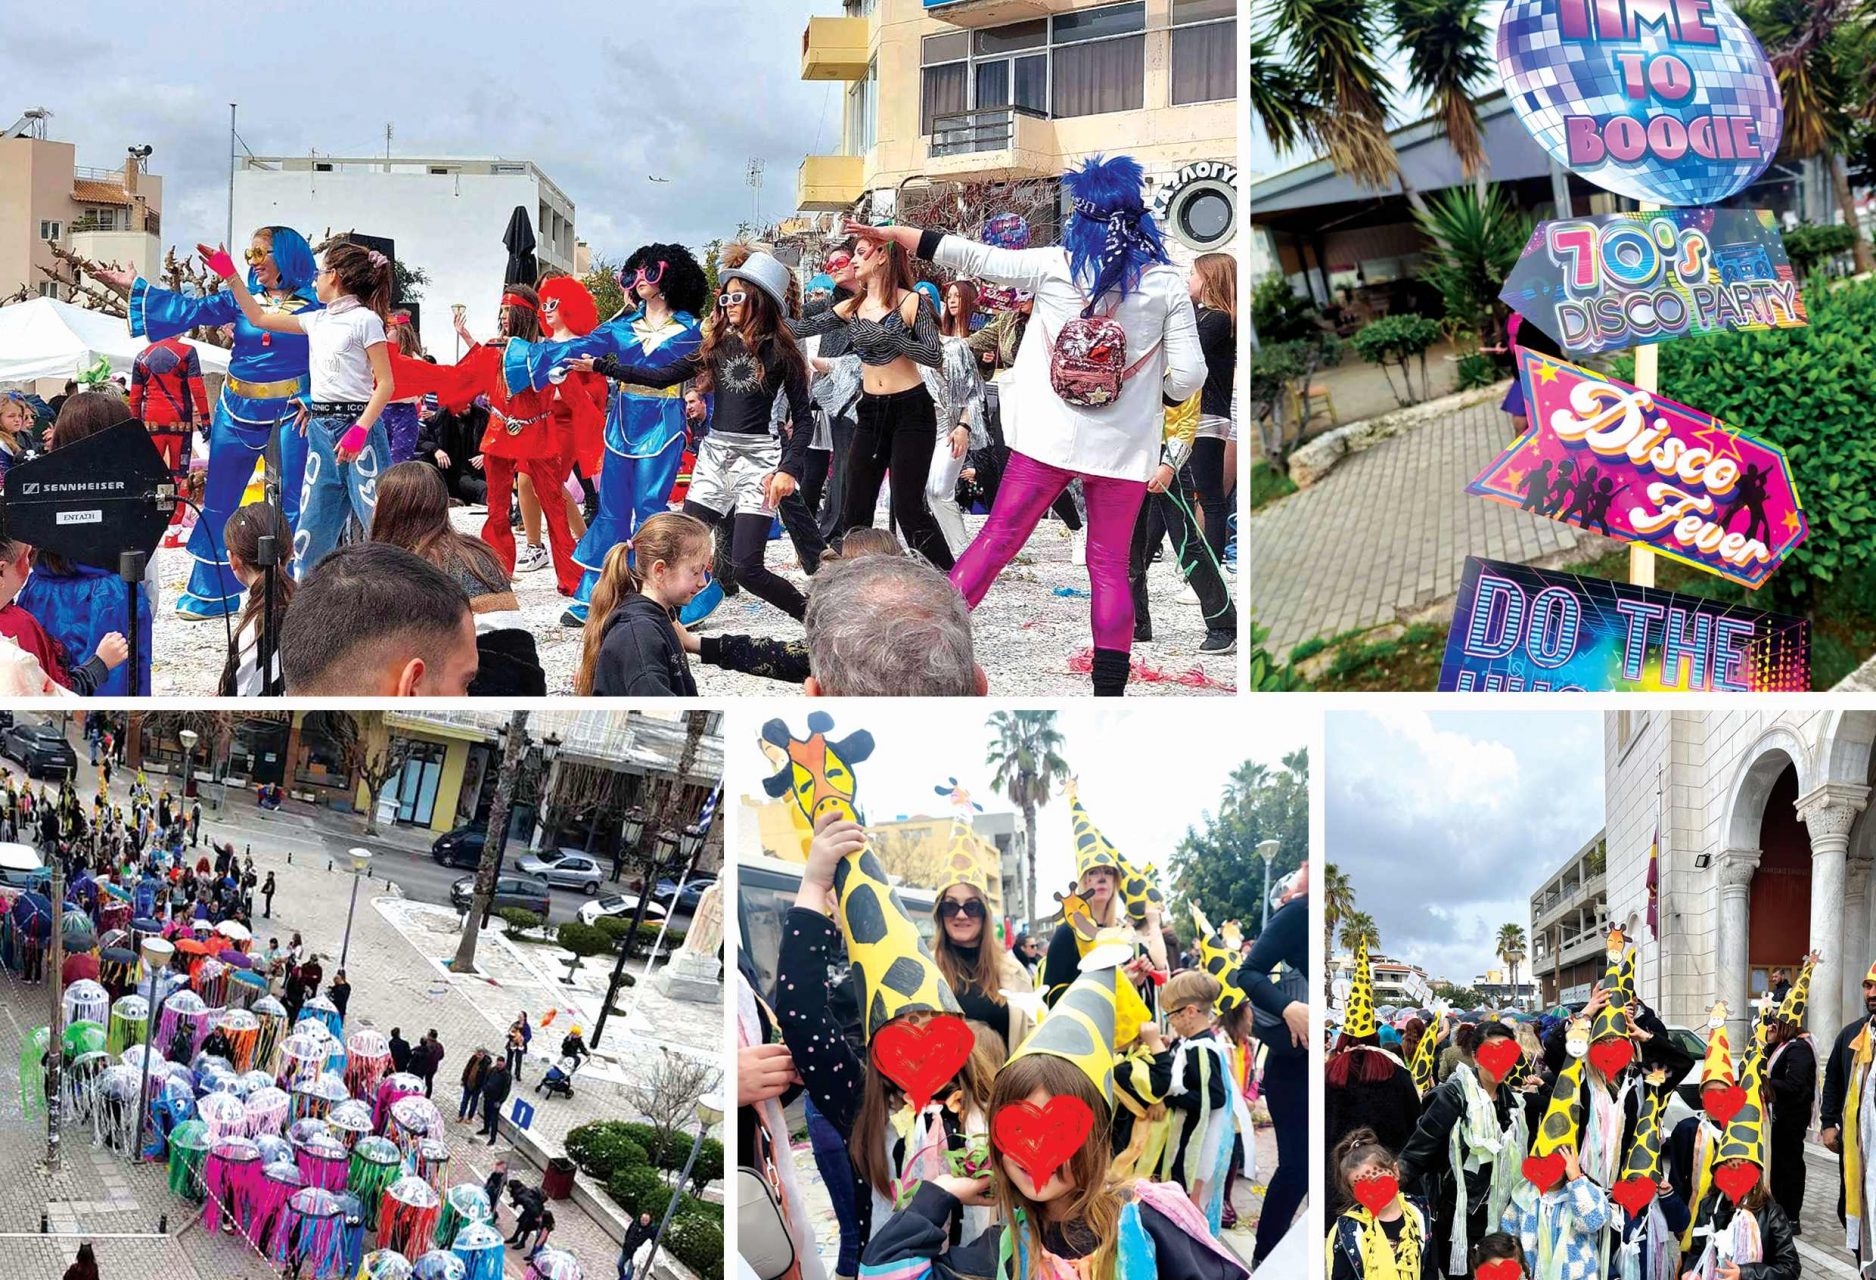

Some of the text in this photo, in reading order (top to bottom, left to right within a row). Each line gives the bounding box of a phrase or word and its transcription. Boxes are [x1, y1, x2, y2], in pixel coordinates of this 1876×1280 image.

[1613, 50, 1694, 105] TO
[1564, 114, 1763, 165] BOOGIE
[1556, 281, 1797, 349] DISCO PARTY
[1551, 380, 1741, 500] Disco
[43, 481, 125, 492] SENNHEISER
[63, 513, 96, 522] ΕΝΤΑΣΗ
[1629, 481, 1775, 567] Fever
[1464, 574, 1756, 692] DO THE
